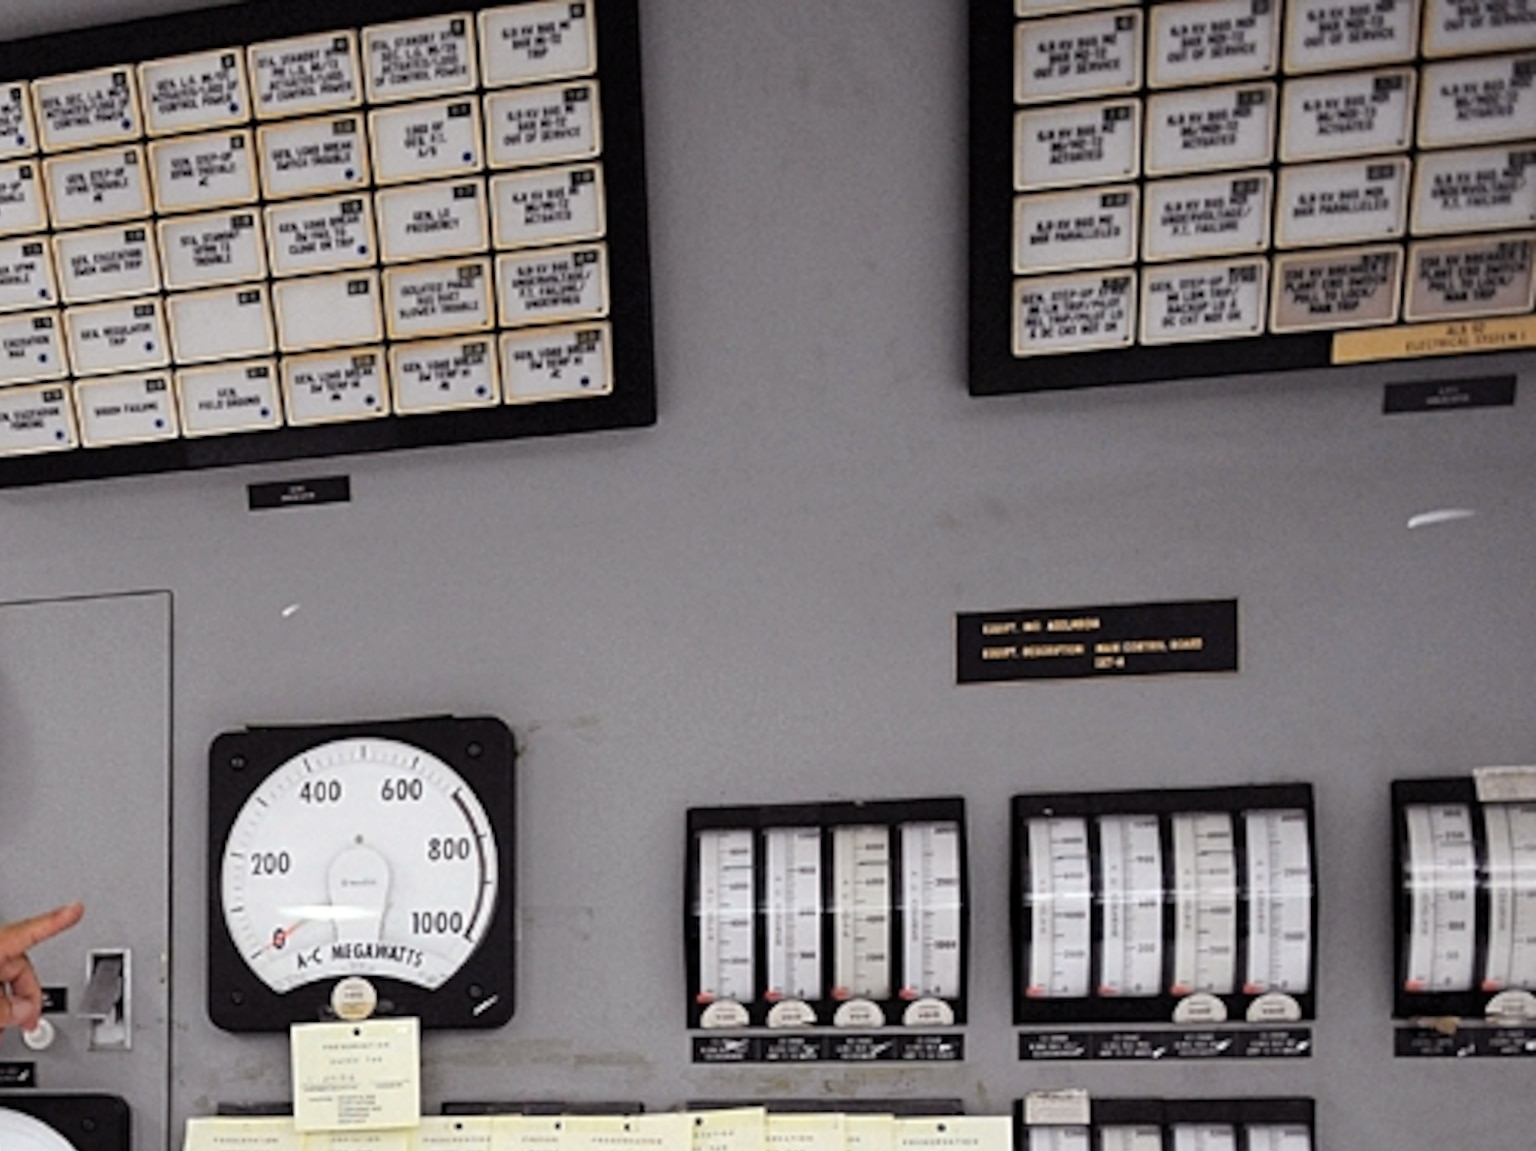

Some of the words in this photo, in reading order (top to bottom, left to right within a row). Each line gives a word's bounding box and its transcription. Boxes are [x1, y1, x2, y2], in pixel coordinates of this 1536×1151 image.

[300, 780, 342, 804] 400
[381, 778, 423, 801] 600
[427, 837, 471, 861] 800
[250, 852, 291, 876] 200
[411, 911, 463, 935] 1000
[296, 947, 322, 970] A-C
[331, 942, 424, 969] MEGAWATTS
